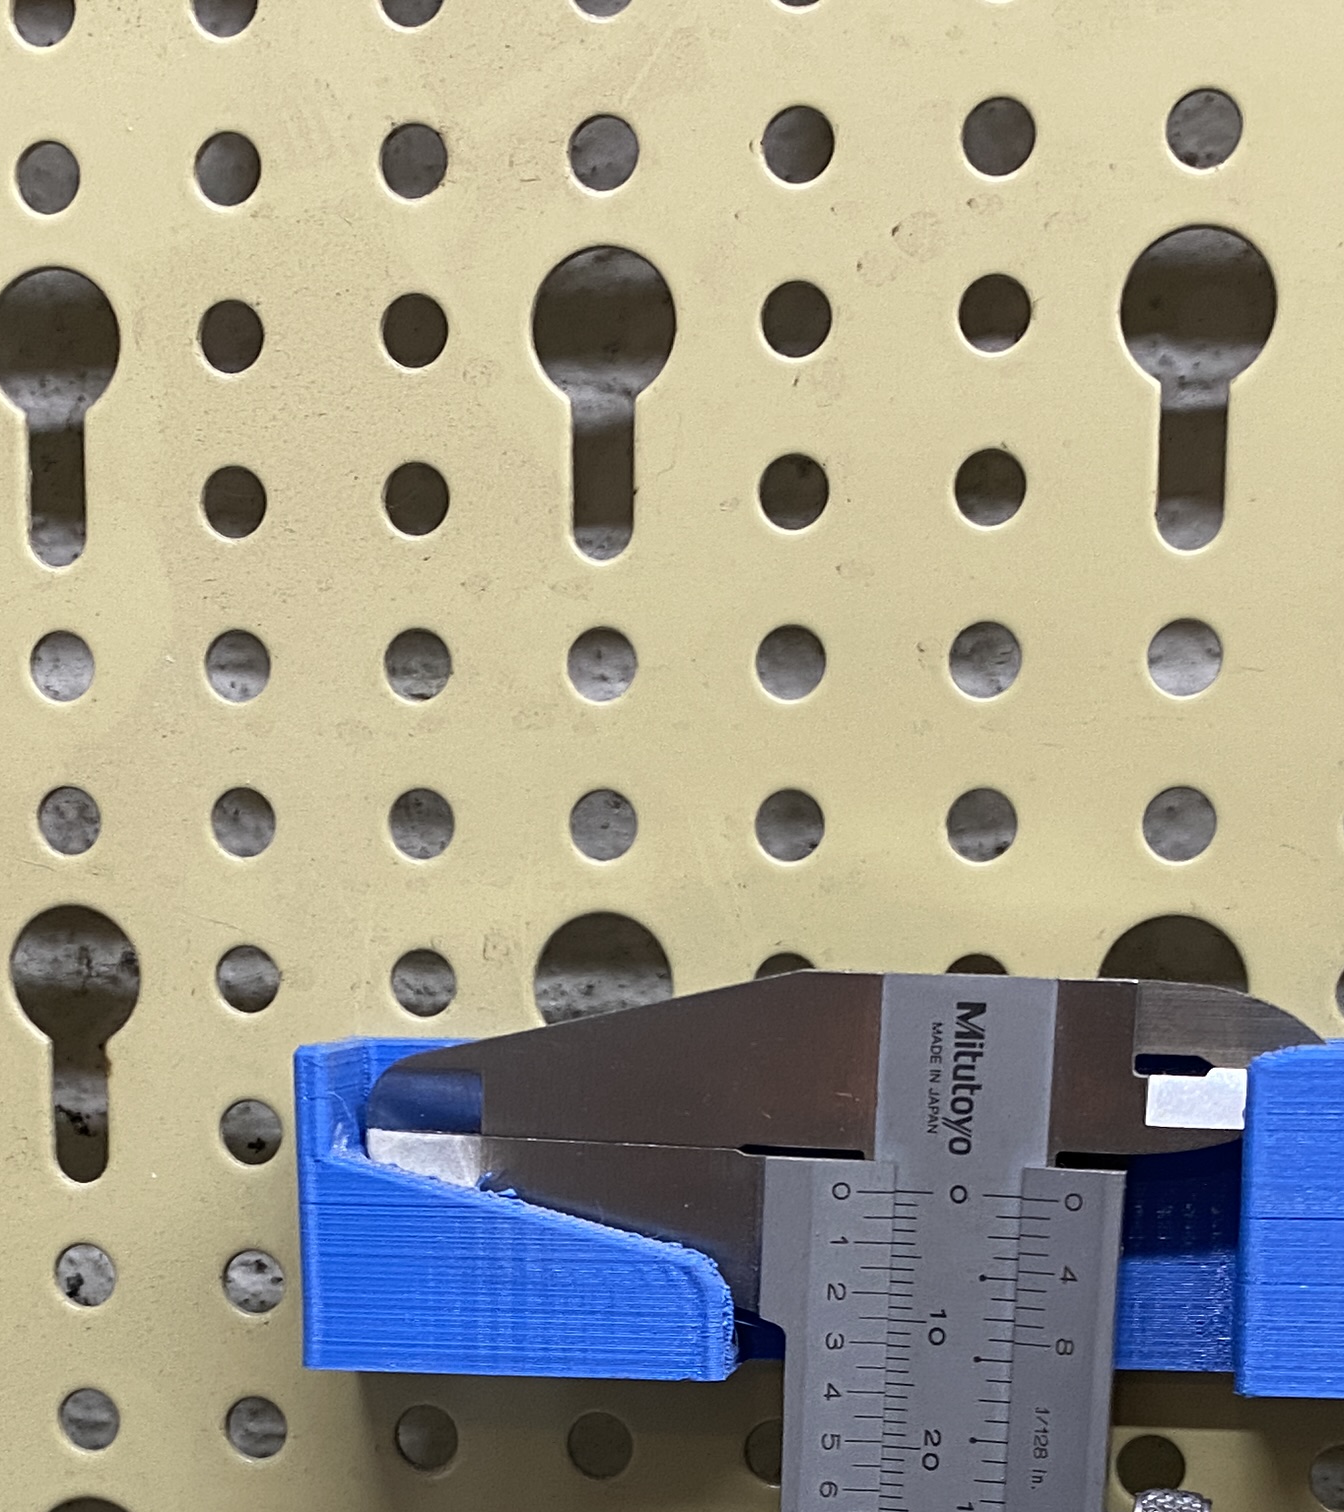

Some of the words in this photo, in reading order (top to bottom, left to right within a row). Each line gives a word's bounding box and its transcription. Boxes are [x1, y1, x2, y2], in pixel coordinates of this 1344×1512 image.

[930, 1021, 944, 1065] MADE
[930, 1067, 941, 1083] IN
[941, 1000, 988, 1157] Mitutoyo
[926, 1086, 941, 1135] JAPAN
[832, 1181, 851, 1201] 0
[949, 1185, 968, 1204] 0
[1063, 1192, 1084, 1212] 0
[829, 1235, 849, 1247] 1
[1058, 1265, 1078, 1285] 4
[827, 1283, 847, 1302] 2
[927, 1310, 947, 1346] 10
[825, 1333, 845, 1351] 3
[1055, 1338, 1075, 1356] 8
[822, 1382, 842, 1401] 4
[821, 1433, 841, 1450] 5
[1030, 1407, 1051, 1461] 1/128
[922, 1429, 942, 1472] 20
[818, 1481, 838, 1498] 6
[956, 1502, 975, 1512] 1
